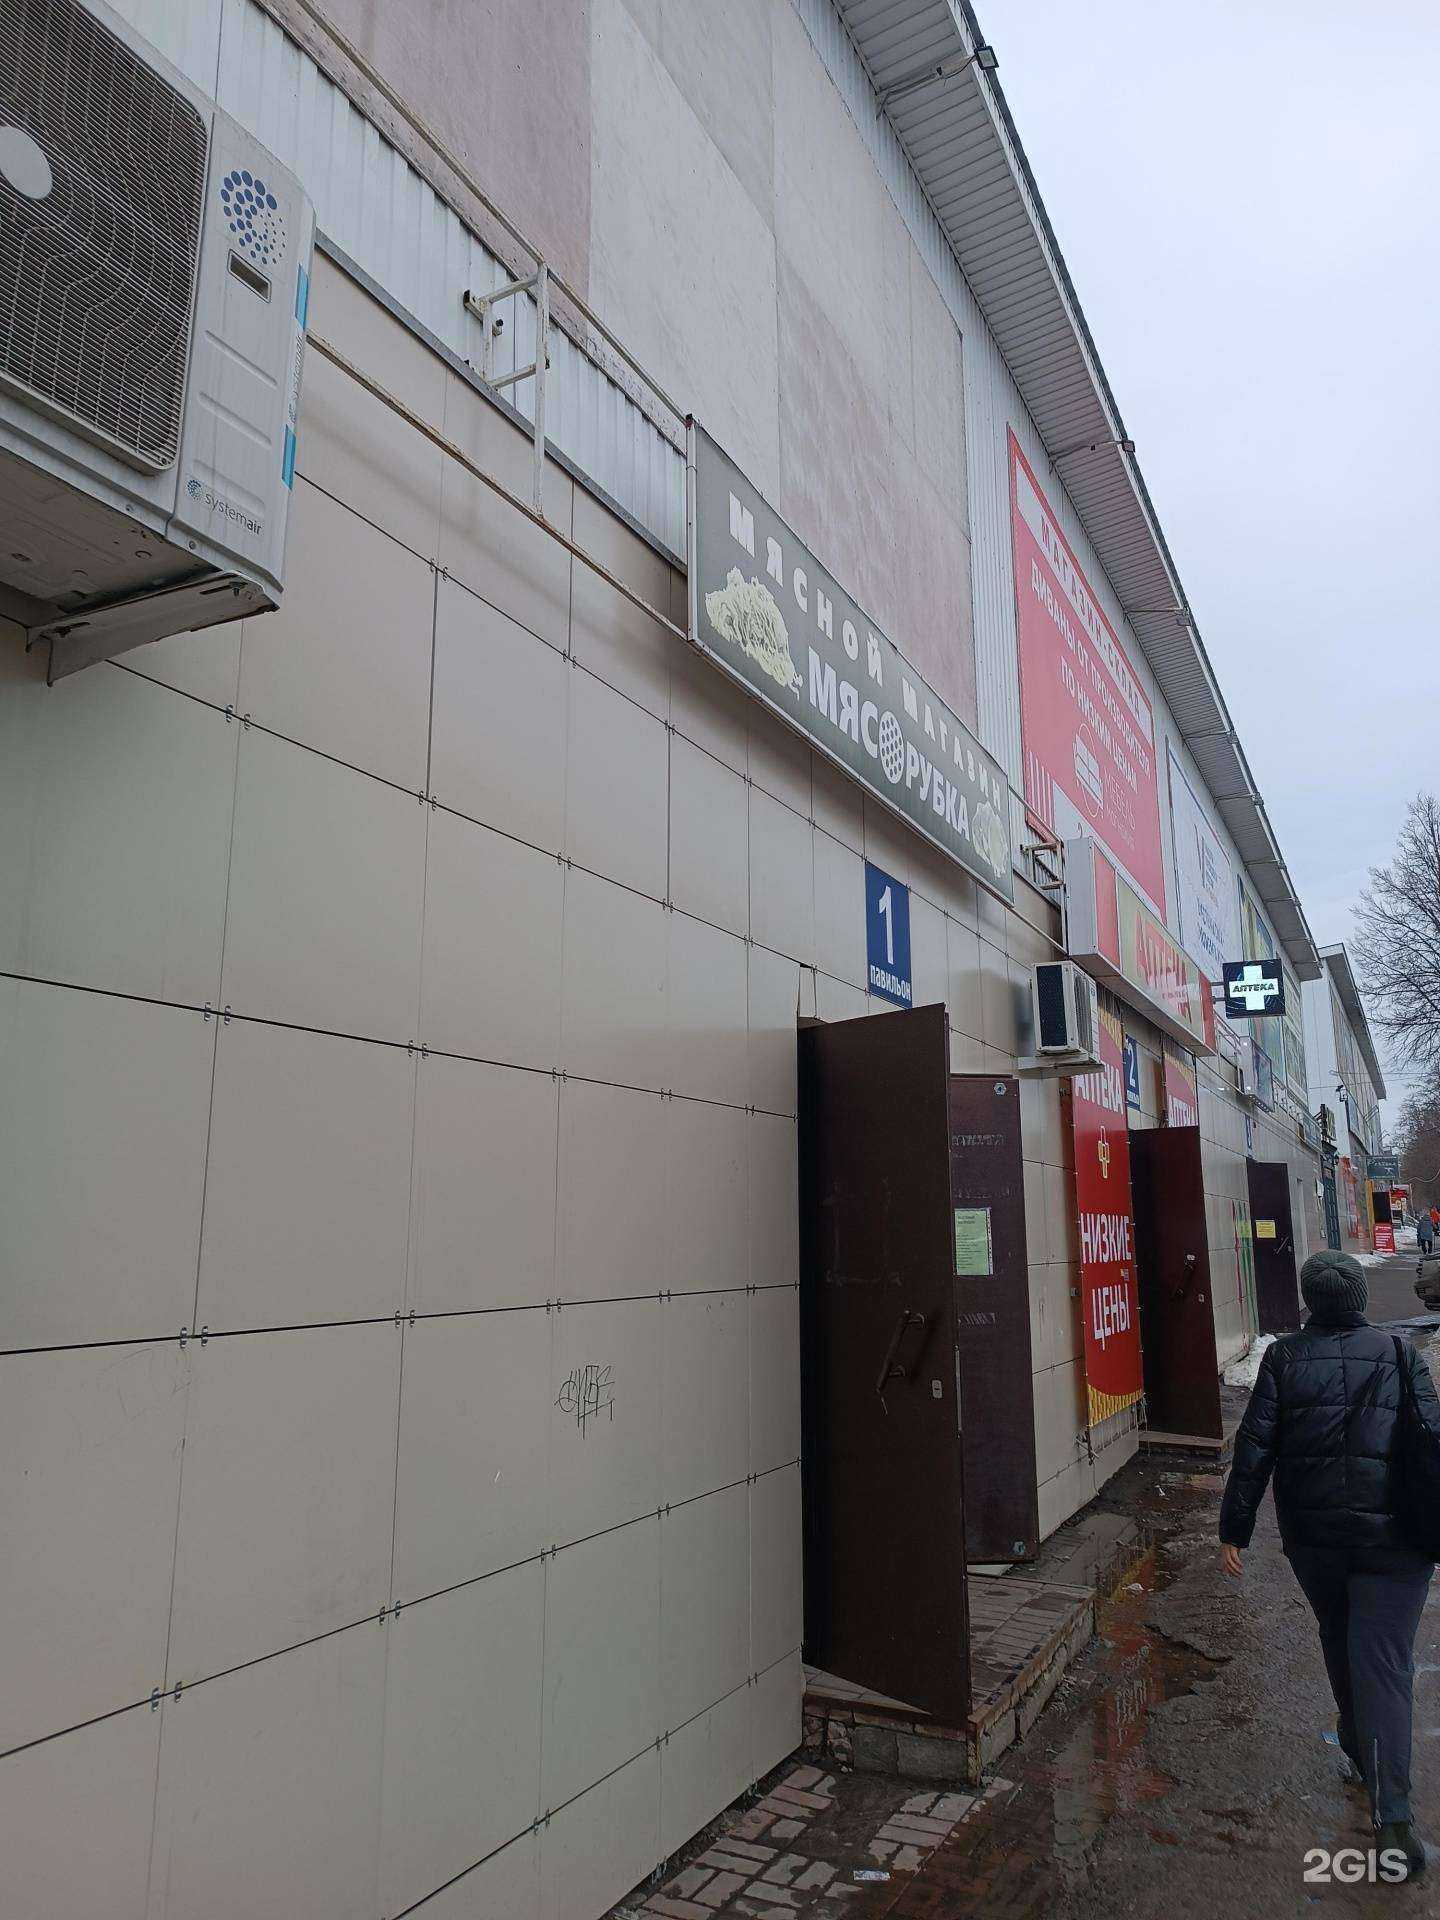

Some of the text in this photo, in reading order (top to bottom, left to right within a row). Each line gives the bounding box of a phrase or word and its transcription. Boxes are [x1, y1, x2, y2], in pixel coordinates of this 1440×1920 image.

[205, 493, 262, 534] systemair
[728, 490, 1001, 811] МЯСНОЙ МАГАЗИН
[1031, 558, 1077, 654] ДИВАНЫ
[1077, 640, 1090, 677] ОТ
[1060, 656, 1076, 698] ПО
[1077, 682, 1112, 755] НИЗКИМ
[808, 647, 971, 843] МЯСОРУБКА
[878, 885, 894, 965] 1
[870, 964, 911, 1001] павильон
[1232, 982, 1275, 993] АПТЕКА
[1127, 1042, 1136, 1087] 2
[1081, 1213, 1132, 1264] НИЗКИЕ
[1092, 1283, 1130, 1350] ЦЕНЫ
